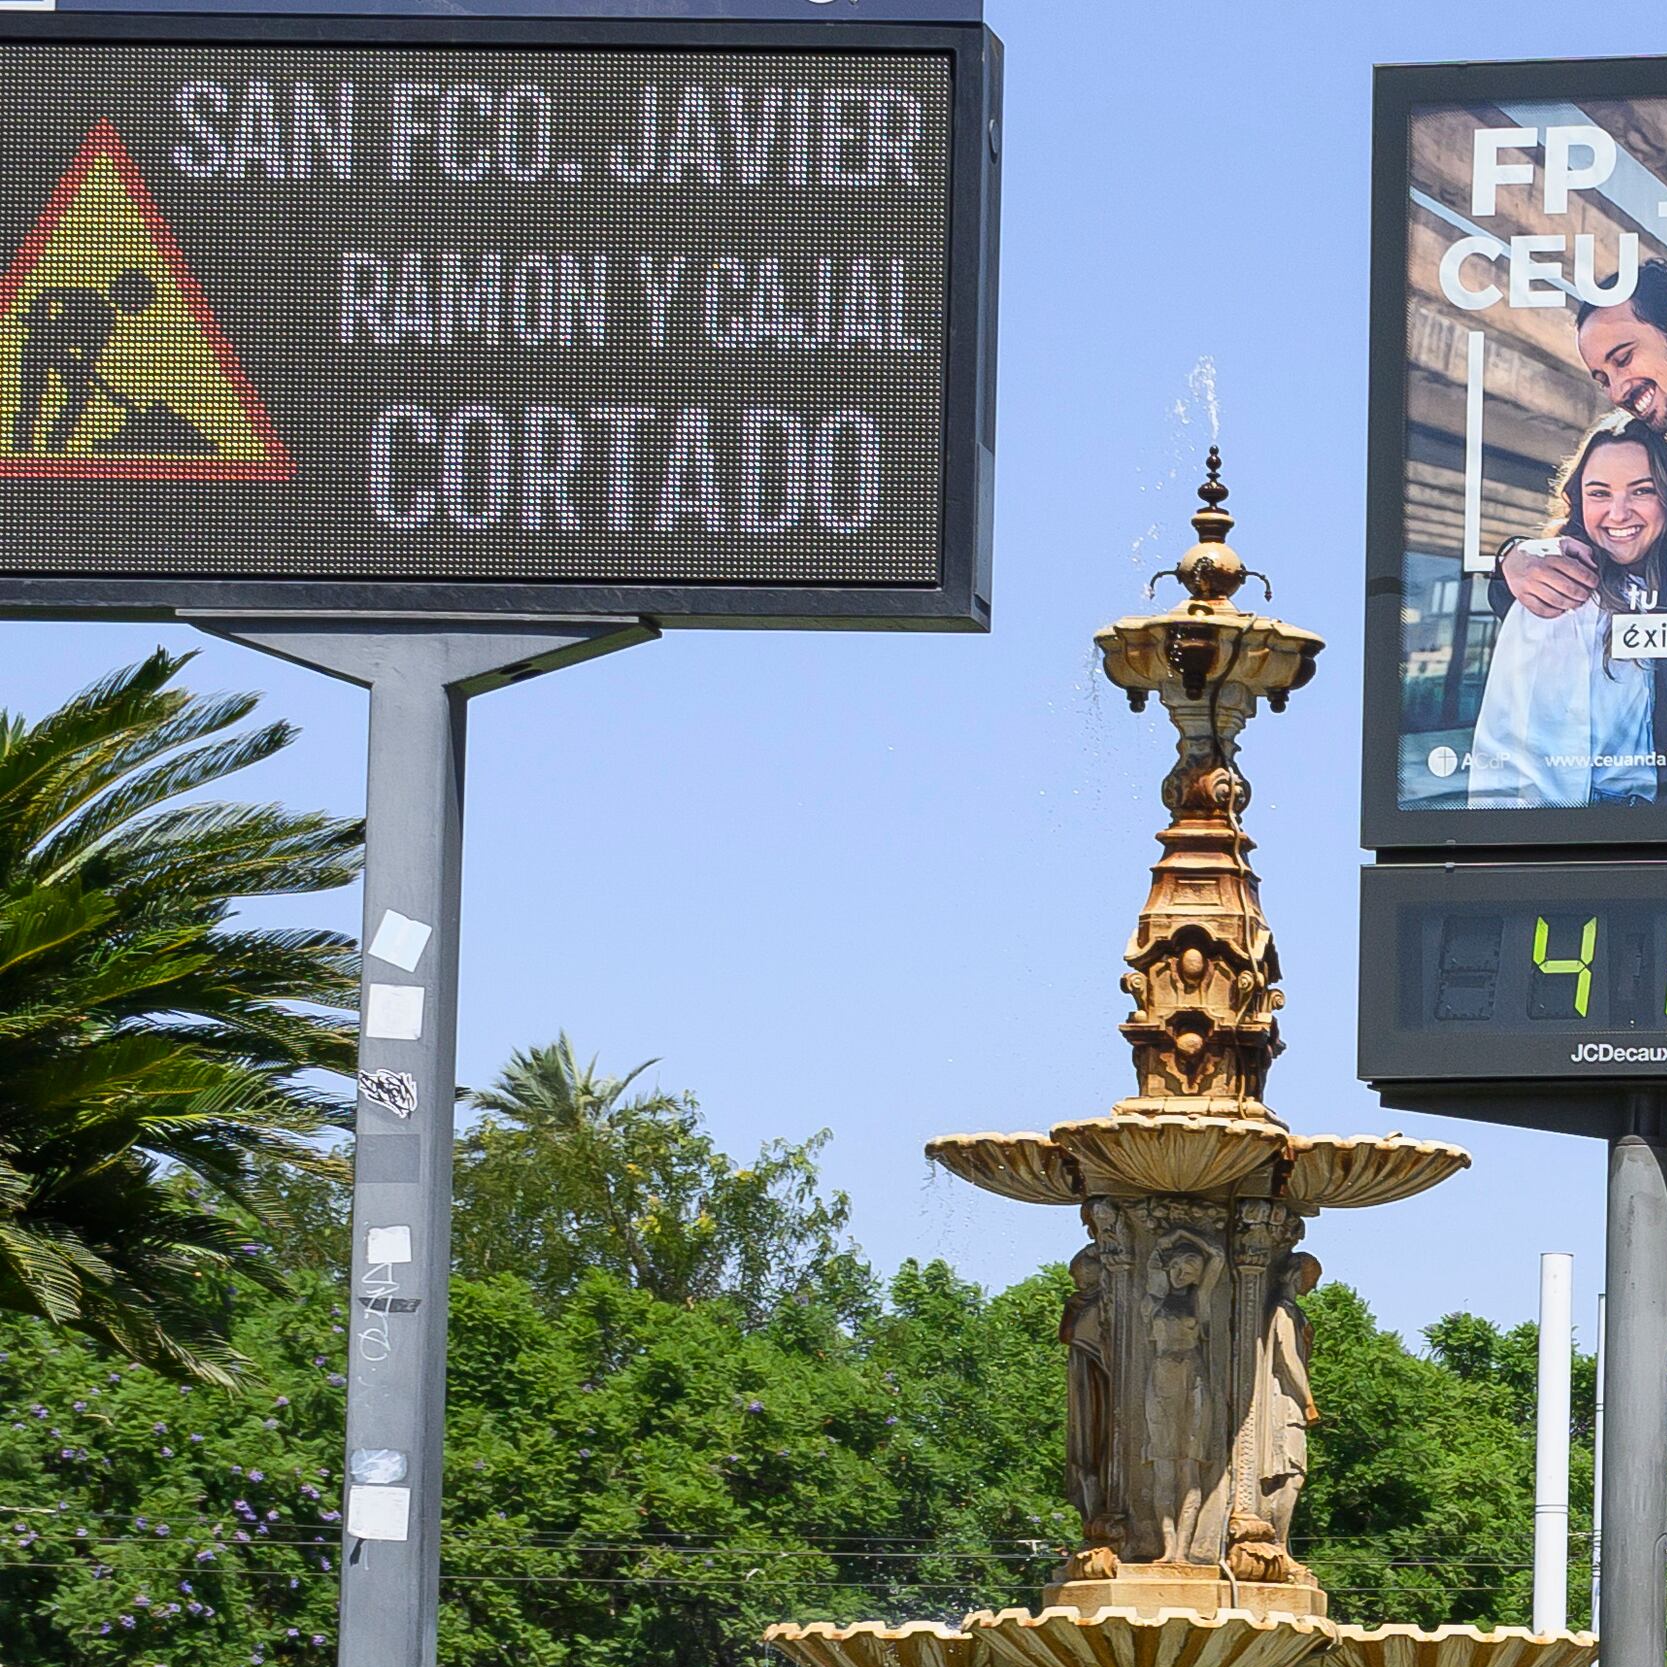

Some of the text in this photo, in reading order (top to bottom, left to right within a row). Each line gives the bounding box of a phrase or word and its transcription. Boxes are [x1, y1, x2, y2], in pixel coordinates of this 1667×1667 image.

[171, 79, 925, 188] SAN FCO. JAVIER
[1472, 125, 1618, 217] FP
[338, 250, 925, 352] RAMON Y CAJAL
[1438, 231, 1640, 312] CEU
[368, 404, 883, 536] CORTADO
[1627, 582, 1659, 611] tu
[1460, 752, 1513, 771] ACdP
